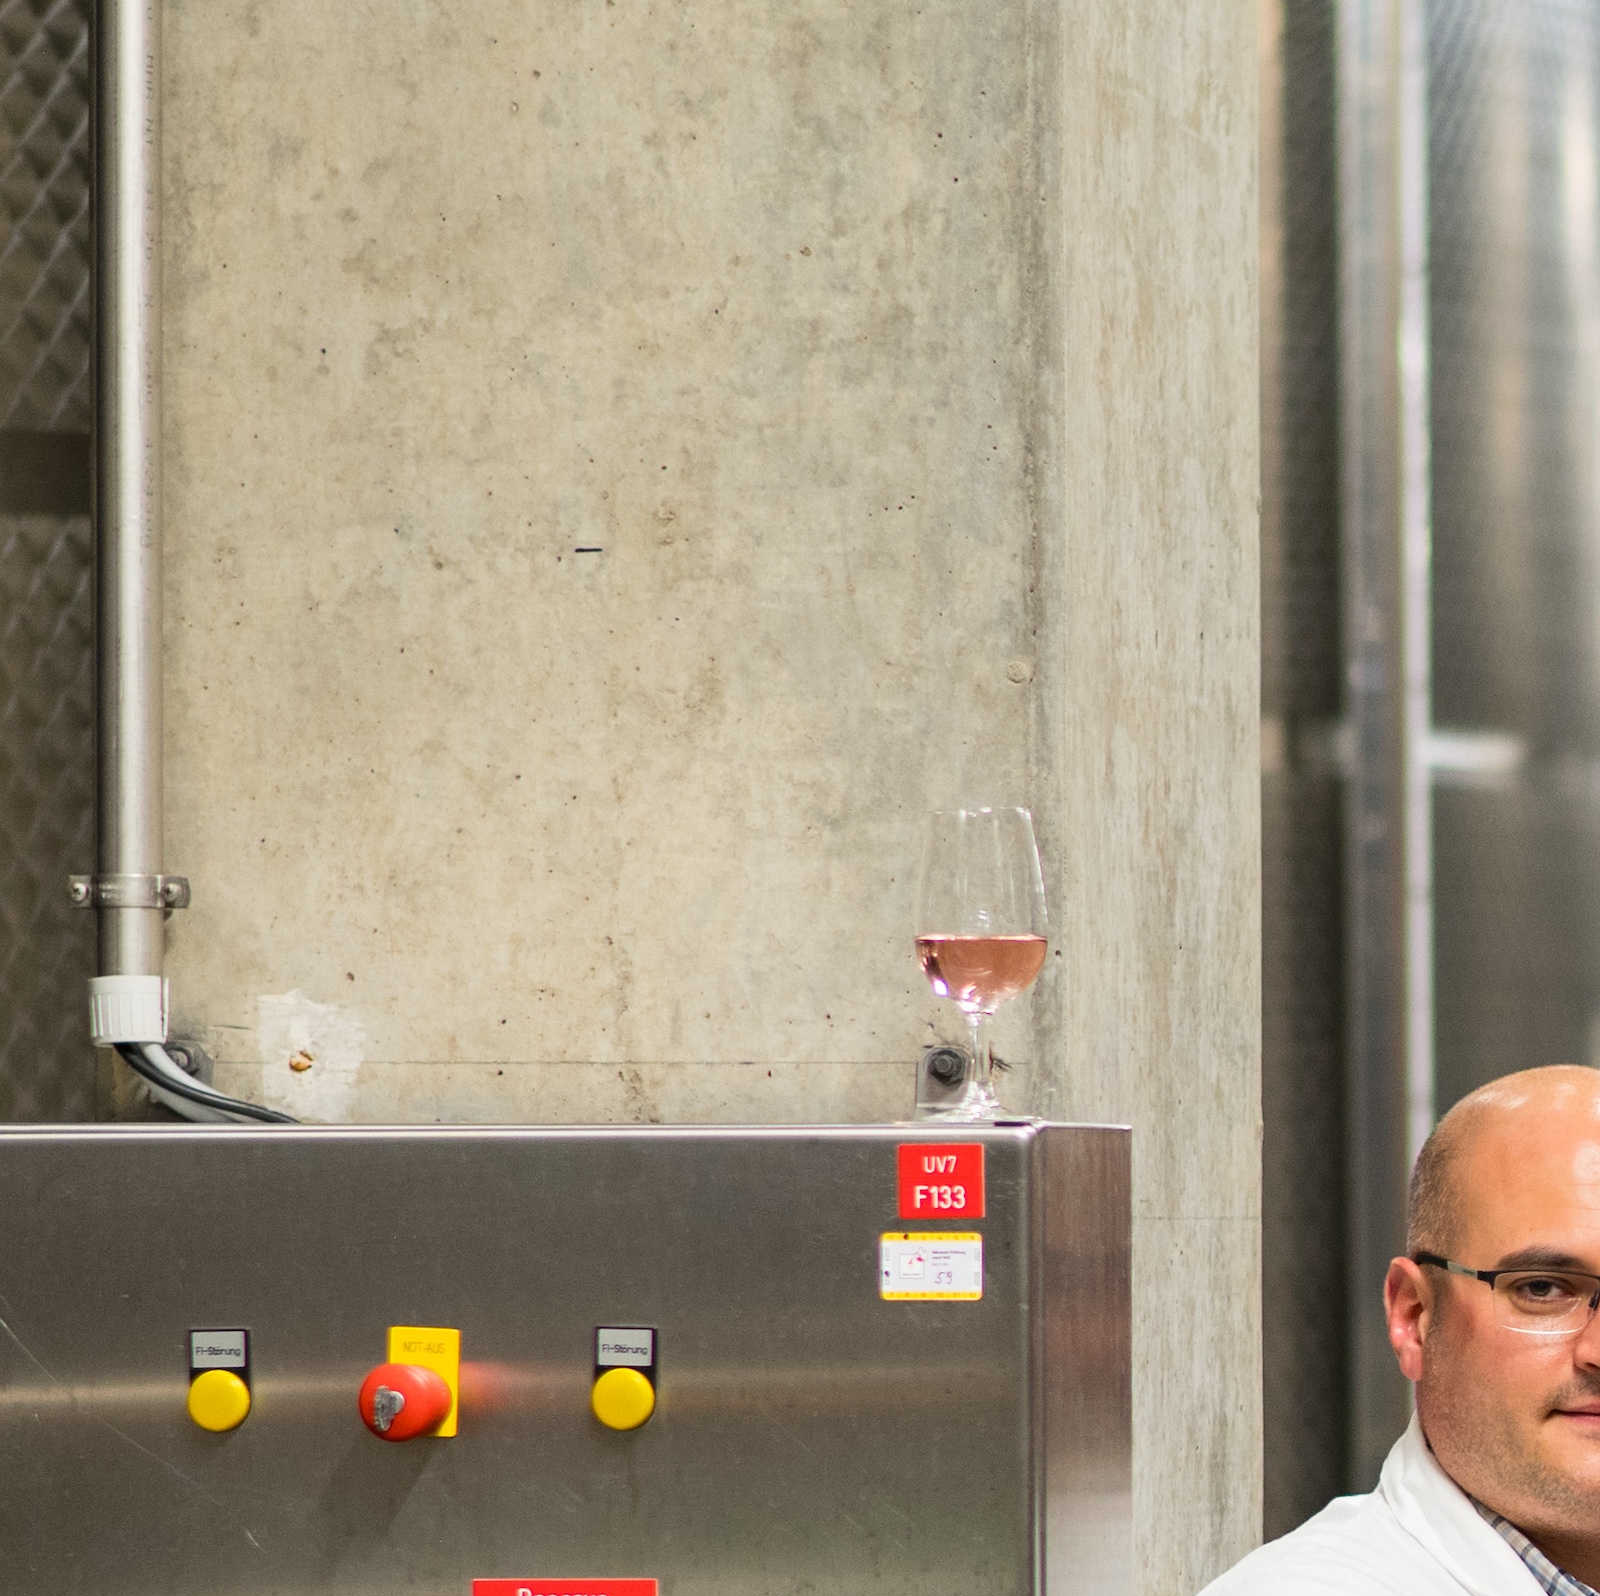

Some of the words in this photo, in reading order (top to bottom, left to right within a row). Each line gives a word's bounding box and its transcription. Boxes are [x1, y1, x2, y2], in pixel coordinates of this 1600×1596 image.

[923, 1155, 957, 1174] UV7
[914, 1185, 966, 1209] F133
[403, 1341, 445, 1354] NOT-AUS
